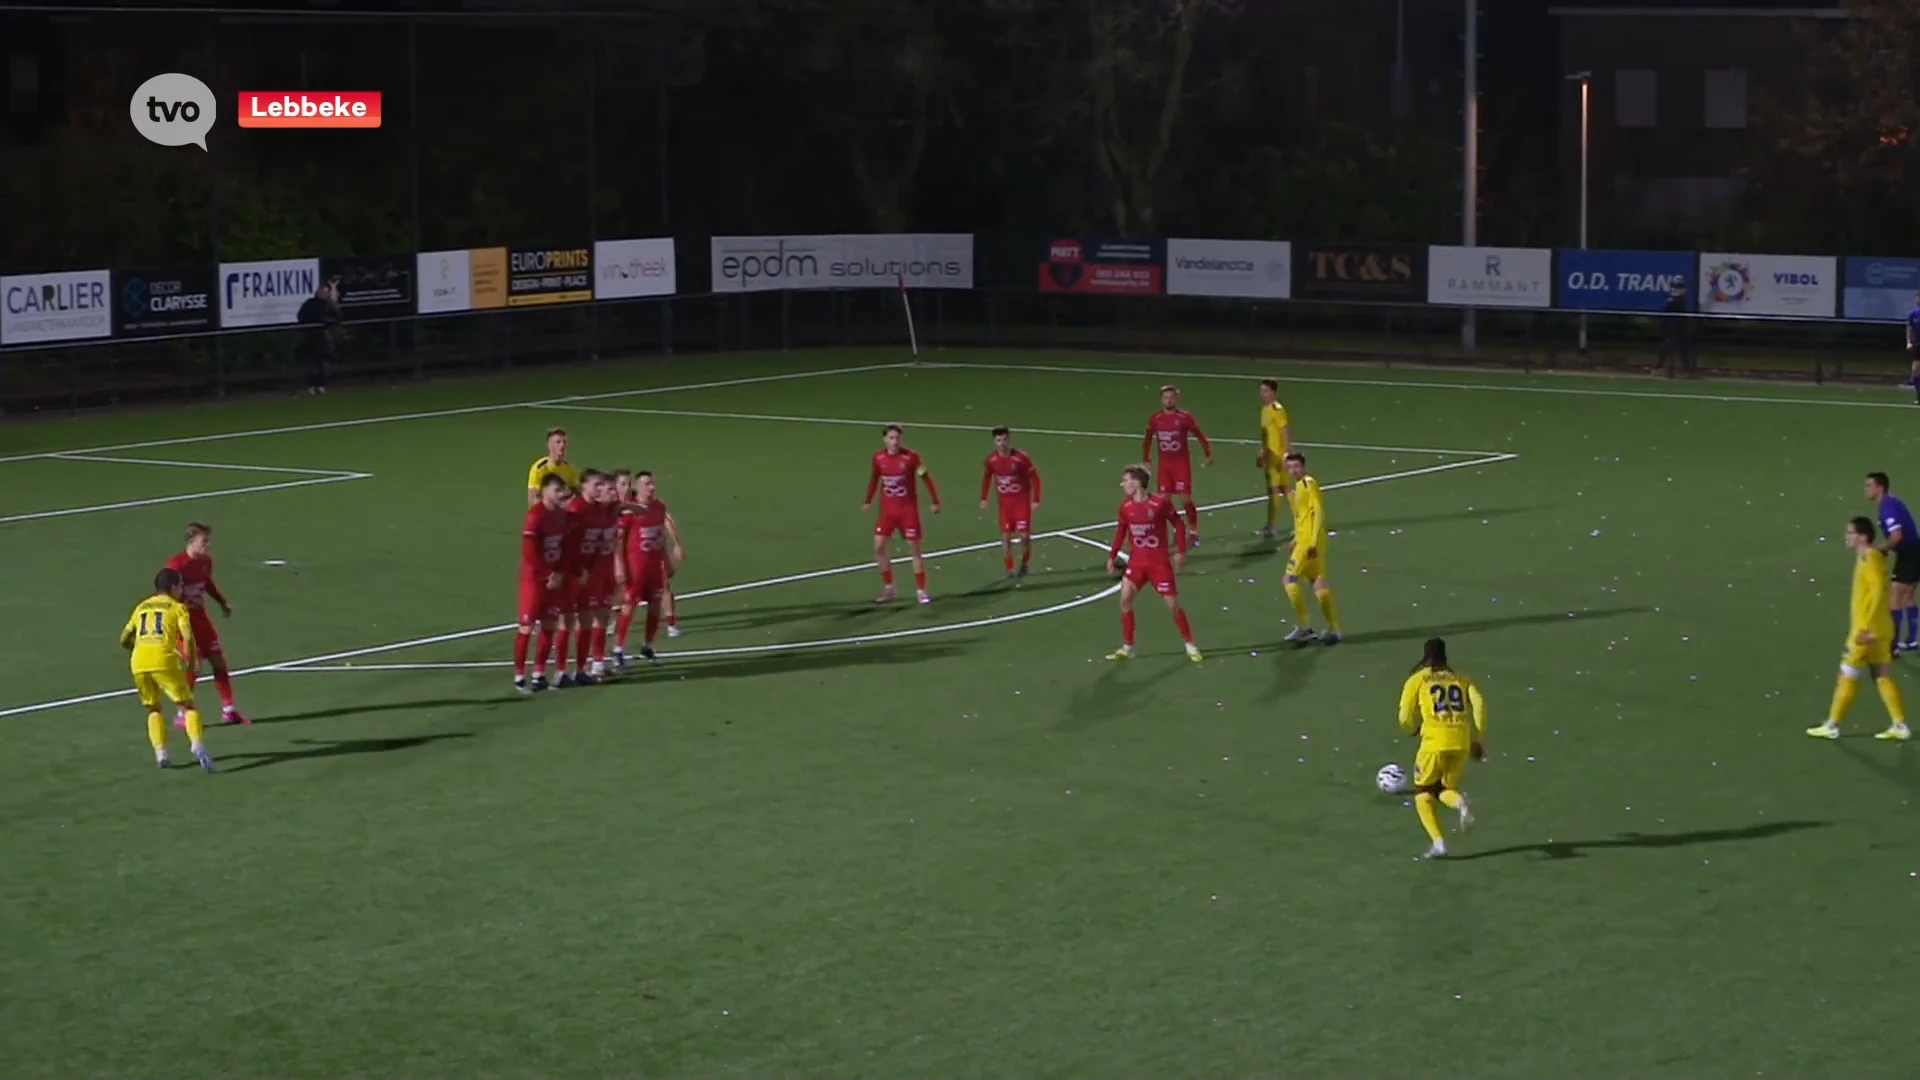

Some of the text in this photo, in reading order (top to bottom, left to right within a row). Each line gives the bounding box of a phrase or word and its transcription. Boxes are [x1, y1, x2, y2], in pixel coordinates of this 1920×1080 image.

[511, 249, 589, 272] EUROPRINTS
[722, 239, 961, 287] epdm solutions
[1309, 251, 1412, 281] TC&S
[1485, 255, 1501, 276] R
[242, 269, 313, 298] FRAIKIN
[1448, 279, 1539, 293] RAMMANT
[1568, 272, 1609, 290] O.D.
[1774, 272, 1819, 286] VIBOL
[7, 282, 104, 314] CARLIER
[150, 294, 208, 312] CLARYSSE
[140, 611, 163, 636] 11
[1430, 684, 1465, 712] 29
